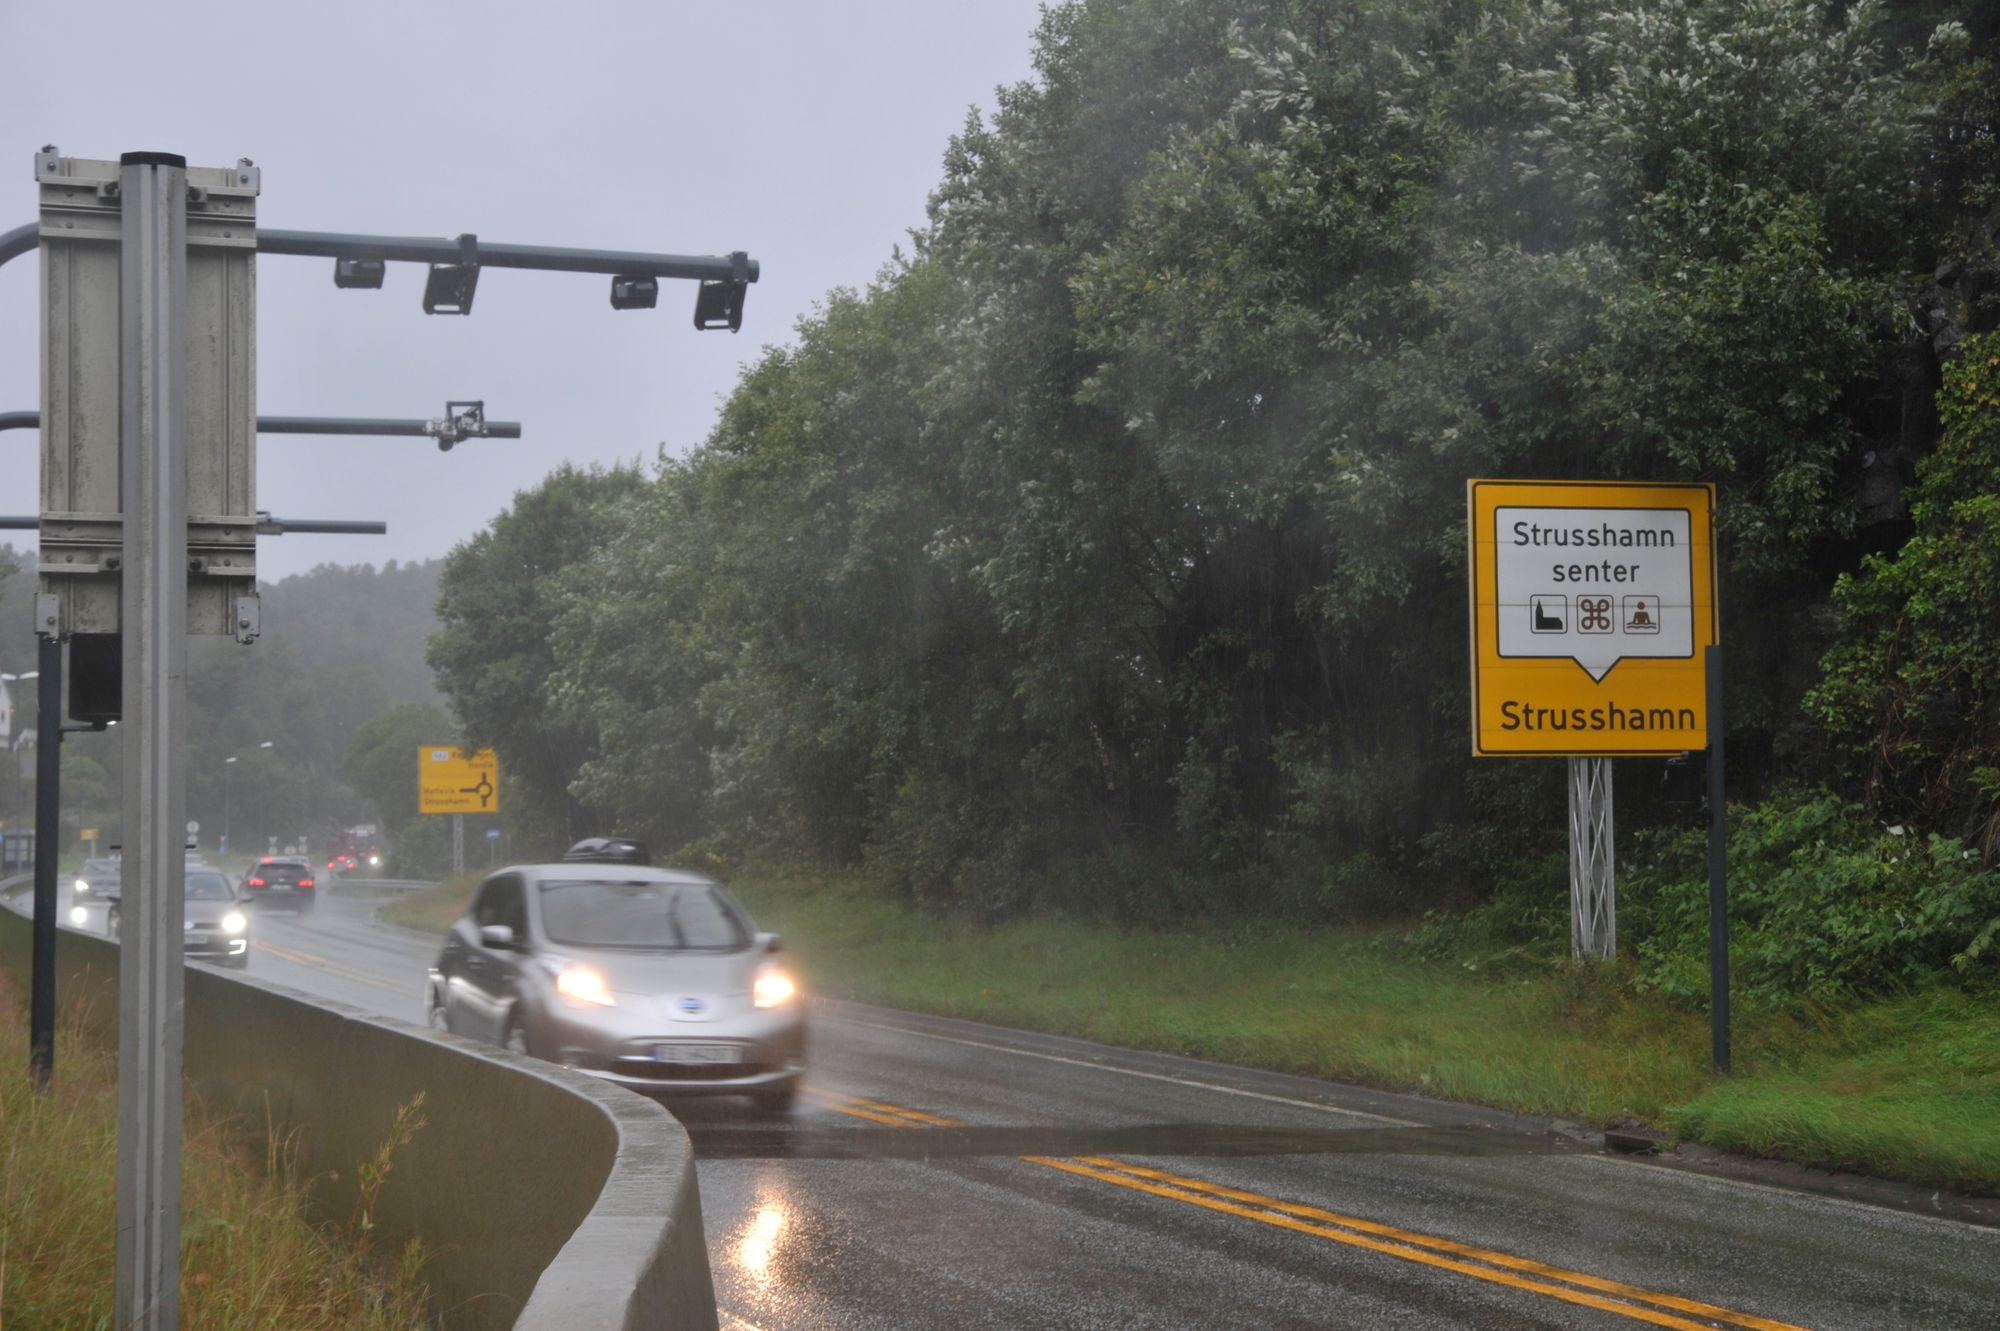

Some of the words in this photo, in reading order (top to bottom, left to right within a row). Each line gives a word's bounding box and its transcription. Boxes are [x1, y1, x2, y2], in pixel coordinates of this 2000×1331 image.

[1513, 522, 1675, 548] Strusshamn
[1552, 560, 1640, 583] senter
[1500, 701, 1696, 731] Strusshamn
